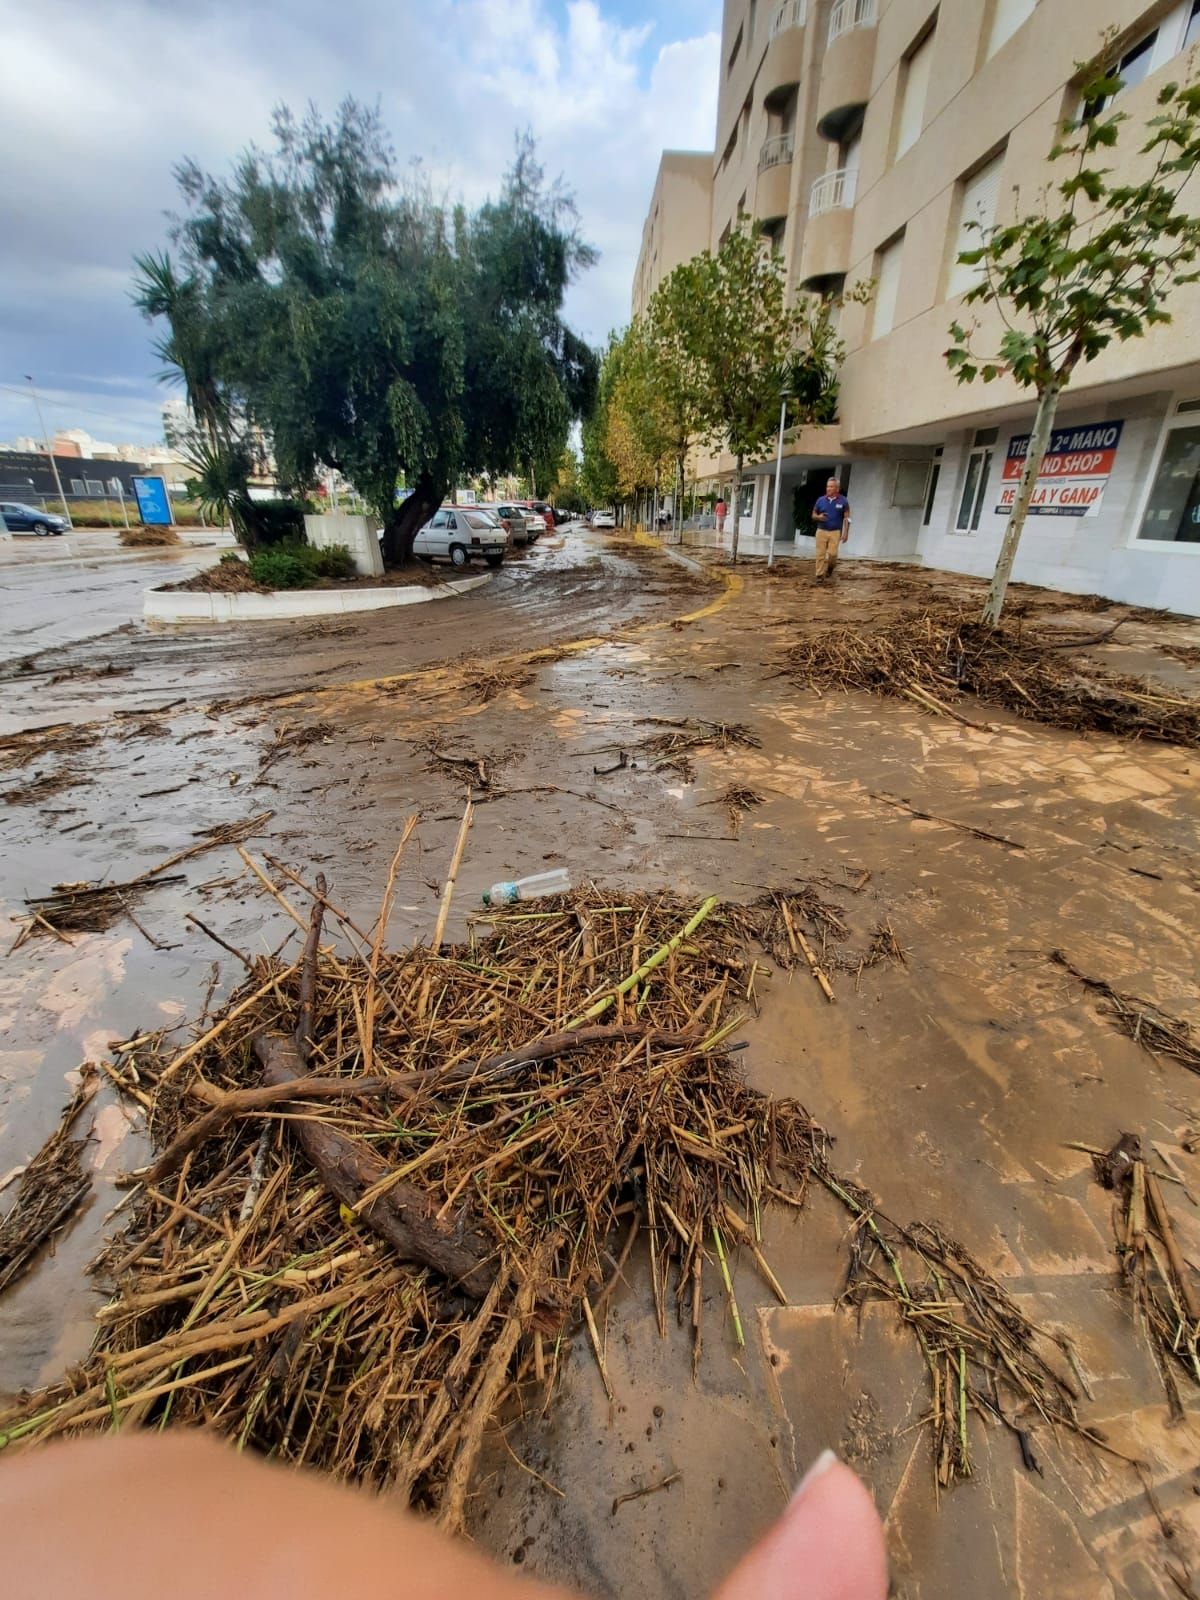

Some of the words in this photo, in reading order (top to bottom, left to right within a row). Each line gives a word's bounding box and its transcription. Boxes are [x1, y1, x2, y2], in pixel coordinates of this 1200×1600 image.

[1053, 436, 1069, 451] 2ª
[1070, 427, 1116, 449] MANO
[1042, 457, 1061, 473] ND
[1063, 454, 1102, 472] SHOP
[1049, 488, 1058, 503] Y
